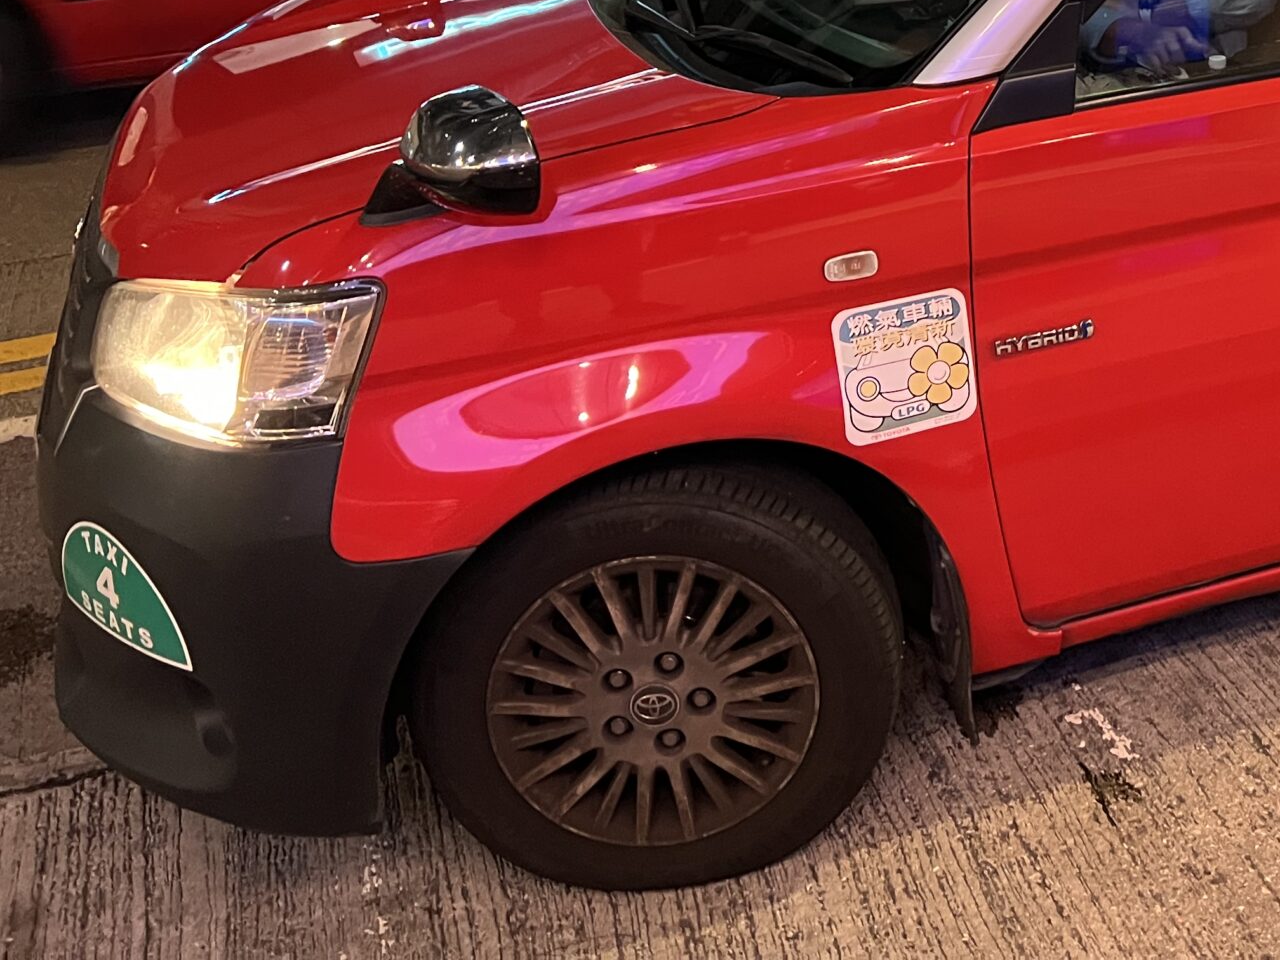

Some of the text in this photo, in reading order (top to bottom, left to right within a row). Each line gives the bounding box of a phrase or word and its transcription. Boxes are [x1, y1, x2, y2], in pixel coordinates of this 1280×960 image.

[847, 297, 954, 338] 燃氣車輛
[994, 326, 1077, 357] HYBRID
[897, 402, 926, 418] LPG
[81, 530, 129, 577] TAXI
[96, 566, 120, 610] 4
[81, 590, 154, 649] SEATS
